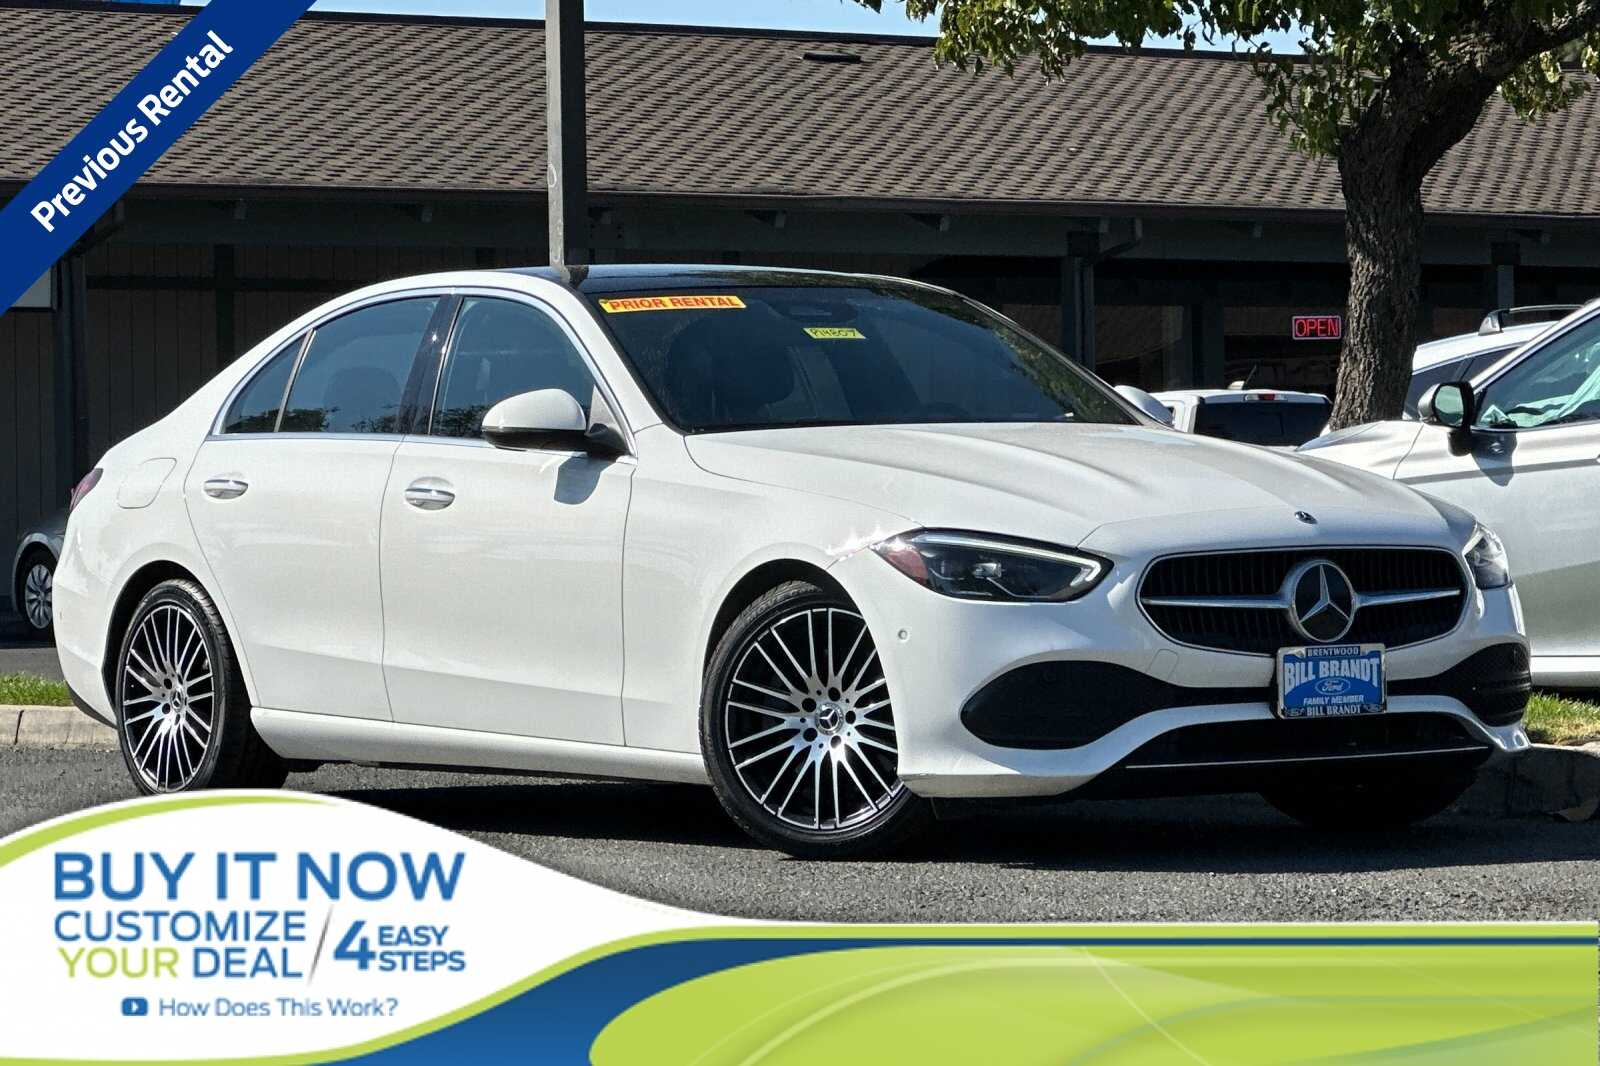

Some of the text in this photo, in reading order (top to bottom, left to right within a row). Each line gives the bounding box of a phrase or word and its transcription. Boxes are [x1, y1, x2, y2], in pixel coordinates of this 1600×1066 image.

[609, 296, 740, 311] PRIOR RENTAL
[1295, 319, 1339, 336] OPEN
[1308, 647, 1359, 657] BRENTWOOD
[1284, 658, 1380, 696] BILL BRANDT
[1304, 695, 1364, 706] FAMILY MEMBER
[1306, 706, 1326, 716] BILL
[1327, 704, 1361, 715] BRANDT
